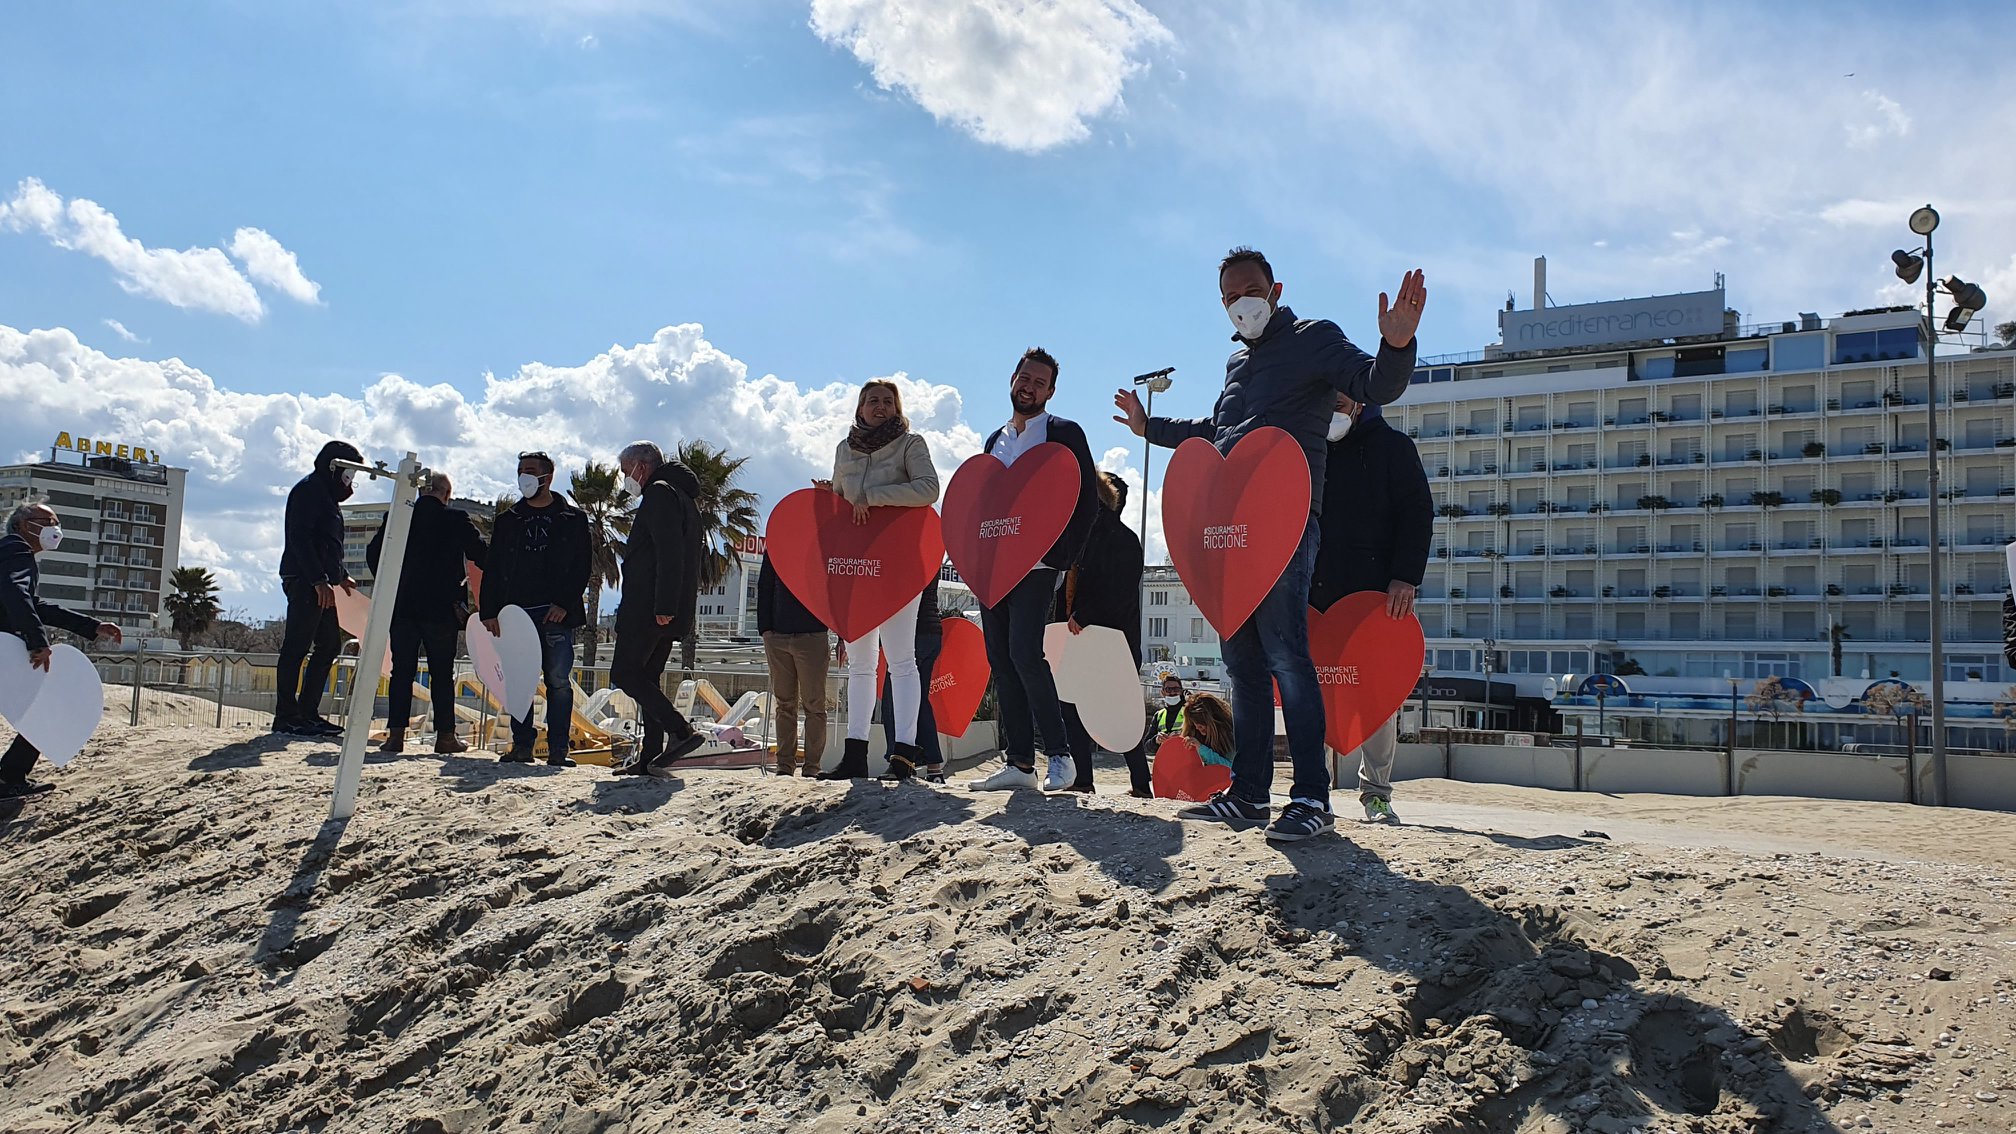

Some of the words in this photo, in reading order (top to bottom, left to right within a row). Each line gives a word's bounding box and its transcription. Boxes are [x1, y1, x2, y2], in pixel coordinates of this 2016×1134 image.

[1519, 309, 1684, 341] mediterraneo
[980, 516, 1022, 528] #SICURAMENTE
[979, 523, 1021, 539] RICCIONE
[1203, 524, 1248, 535] #SICURAMENTE
[1203, 533, 1248, 549] RICCIONE
[828, 557, 881, 566] #SICURAMENTE
[827, 563, 881, 577] RICCIONE
[1314, 665, 1358, 673] CURAMENTE
[1316, 672, 1360, 685] CCIONE
[928, 679, 957, 695] CCIONE
